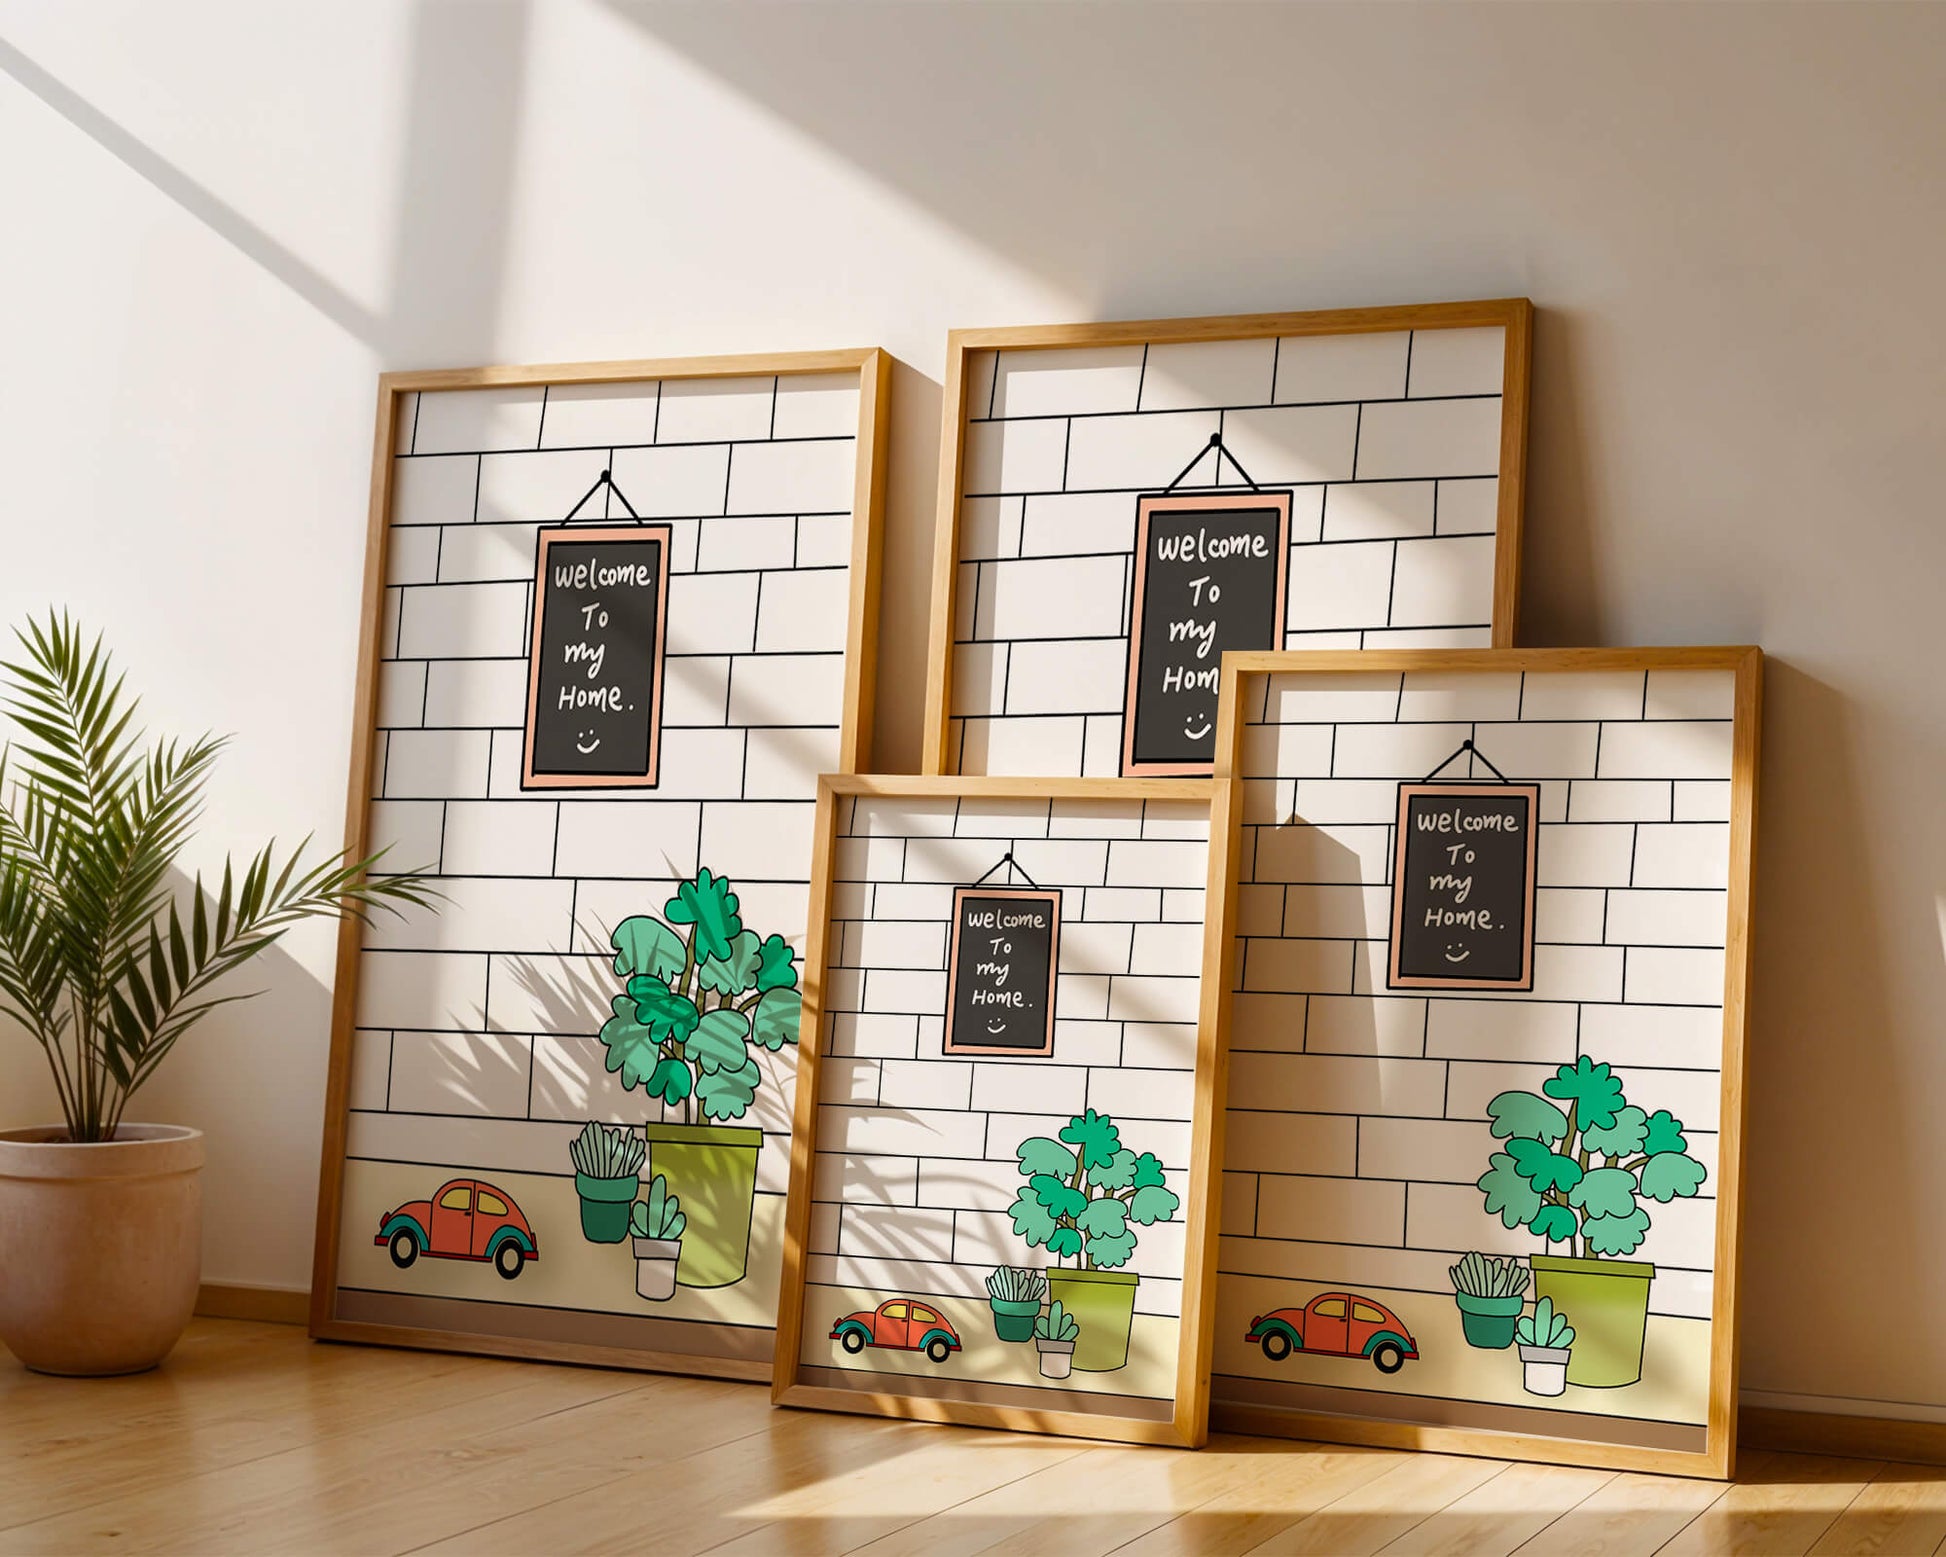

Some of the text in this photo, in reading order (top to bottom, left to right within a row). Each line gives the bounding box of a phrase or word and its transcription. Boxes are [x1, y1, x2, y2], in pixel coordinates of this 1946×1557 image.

[1188, 575, 1221, 607] To
[581, 602, 609, 631] To
[1169, 618, 1217, 659] my
[564, 641, 605, 680] my
[1162, 665, 1219, 695] Hom
[558, 685, 634, 713] Home.
[1446, 843, 1475, 866] To
[1430, 874, 1472, 904] my
[1424, 908, 1505, 930] Home.
[989, 937, 1012, 956] To
[976, 962, 1010, 987] my
[971, 989, 1033, 1008] Home.
